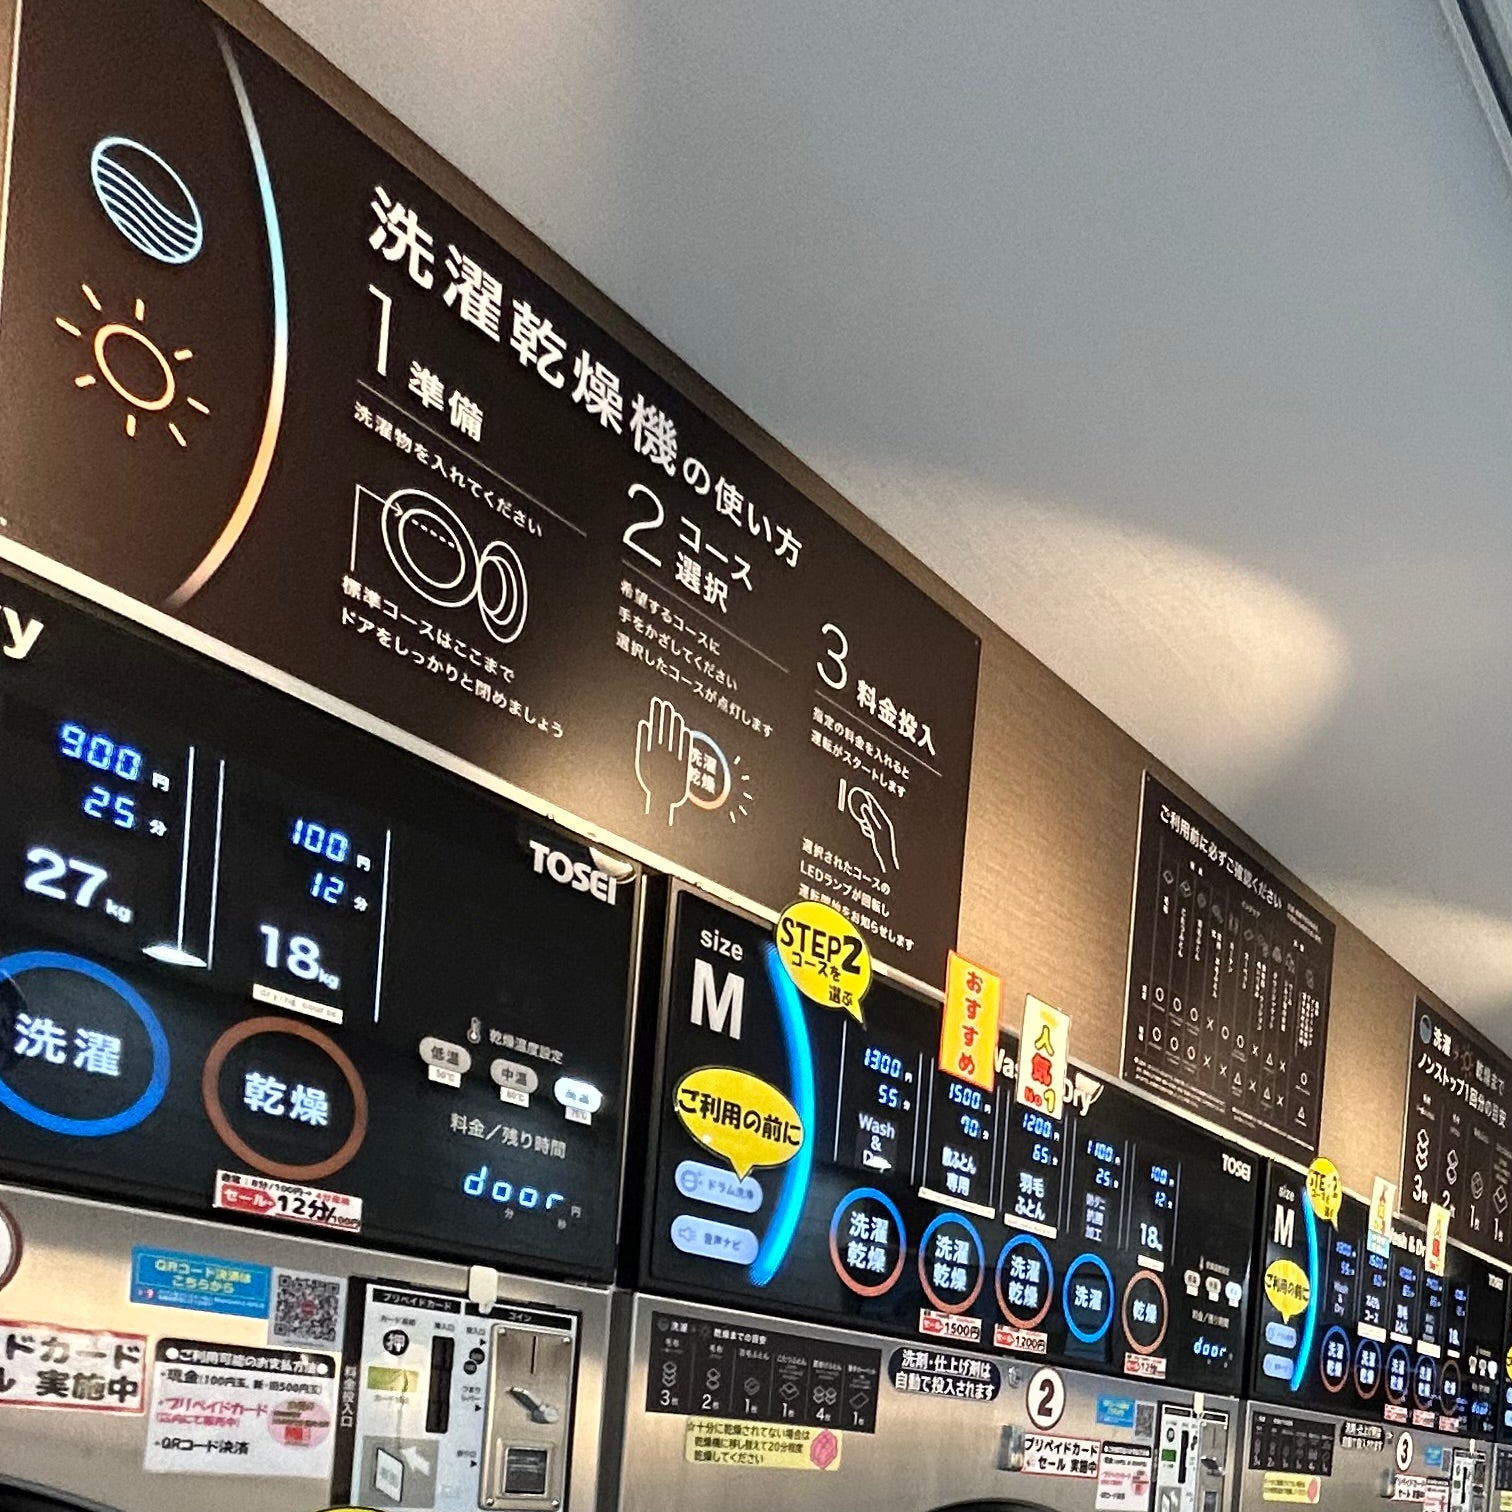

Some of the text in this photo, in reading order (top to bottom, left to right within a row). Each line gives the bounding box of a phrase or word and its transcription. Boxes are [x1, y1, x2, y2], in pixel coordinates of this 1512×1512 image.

[368, 284, 485, 441] 1 準備
[368, 185, 803, 567] 洗濯乾燥機の使い方
[354, 401, 543, 537] 洗濯物を入れてください
[622, 483, 754, 591] 2 コース
[675, 552, 728, 613] 選択
[342, 575, 515, 682] 標準コースはここまで
[620, 579, 720, 655] 希望するコースに
[618, 606, 738, 691] 手をかざしてください
[341, 607, 564, 739] ドアをしっかりと閉めましょう
[616, 631, 773, 738] 選択したコースが点灯します
[816, 622, 936, 756] 3 料金投入
[812, 706, 910, 780] 指定の料金を入れると
[811, 729, 906, 798] 運転がスタートします
[529, 840, 616, 905] TOSEI
[802, 838, 891, 895] 選択されたコースの
[800, 860, 890, 917] LEDランプが回転し
[700, 929, 743, 961] size
[780, 917, 863, 975] STEP2
[792, 951, 841, 982] コースを
[690, 958, 745, 1041] M
[829, 985, 853, 1007] 選ぶ
[958, 971, 983, 1075] おすすめ
[14, 1013, 122, 1076] 洗濯
[1031, 1025, 1054, 1087] 人気
[244, 1072, 328, 1126] 乾燥
[678, 1088, 801, 1146] ご利用の前に
[858, 1112, 896, 1140] Wash
[870, 1135, 881, 1152] &
[946, 1172, 971, 1196] 専用
[1020, 1172, 1044, 1197] 羽毛
[1222, 1153, 1251, 1182] TOSEI
[223, 1187, 272, 1208] セール
[464, 1166, 564, 1209] door
[849, 1210, 889, 1244] 洗濯
[1015, 1196, 1045, 1221] ふとん
[1274, 1204, 1295, 1248] M
[847, 1240, 886, 1273] 乾燥
[935, 1234, 969, 1265] 洗濯
[933, 1262, 967, 1292] 乾燥
[1010, 1254, 1041, 1283] 洗濯
[1008, 1280, 1039, 1309] 乾燥
[1075, 1285, 1103, 1311] 洗濯
[1133, 1300, 1158, 1324] 乾燥
[385, 1332, 406, 1354] 押
[944, 1321, 979, 1341] 1500円
[6, 1333, 140, 1370] ドカード
[902, 1348, 991, 1379] 洗剤・仕上げ剤は
[36, 1369, 139, 1403] 実施中
[895, 1370, 995, 1400] 自動で投入されます
[1037, 1379, 1055, 1417] 2
[1024, 1437, 1098, 1458] プリペイドカード
[1037, 1456, 1097, 1475] セール 実施中
[1400, 1437, 1409, 1465] 3
